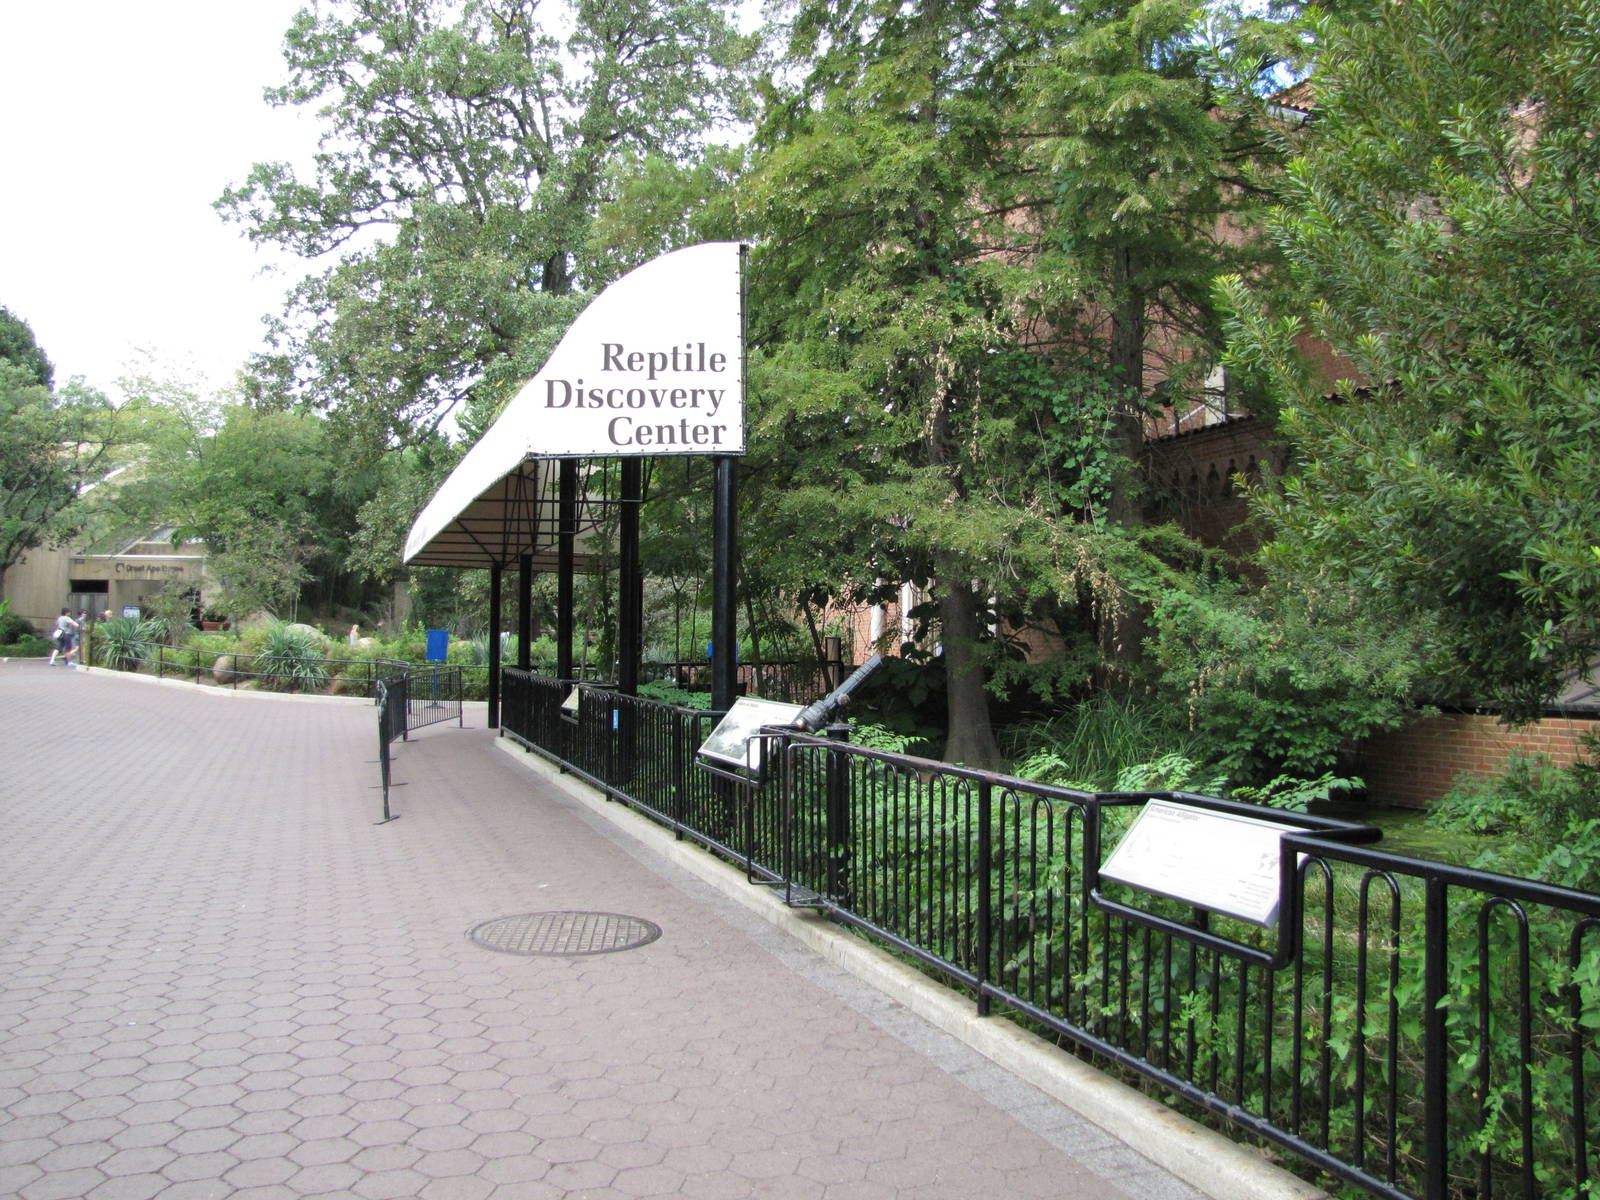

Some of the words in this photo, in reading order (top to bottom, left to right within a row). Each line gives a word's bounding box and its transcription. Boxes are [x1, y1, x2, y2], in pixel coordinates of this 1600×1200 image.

[601, 342, 727, 380] Reptile
[544, 378, 726, 417] Discovery
[608, 416, 727, 446] Center
